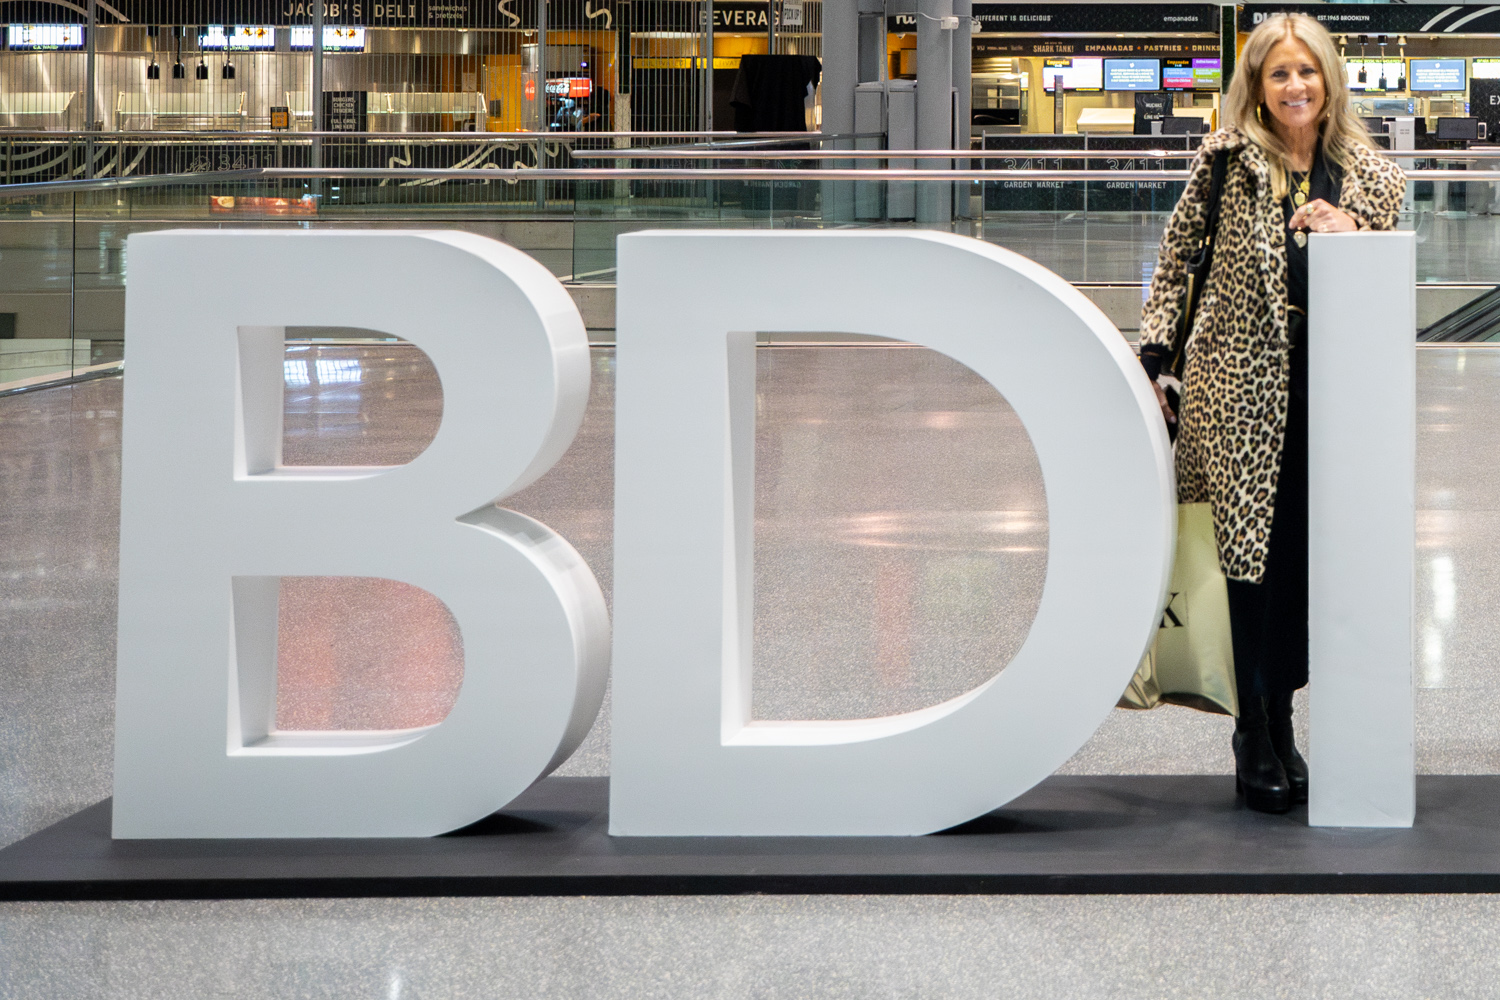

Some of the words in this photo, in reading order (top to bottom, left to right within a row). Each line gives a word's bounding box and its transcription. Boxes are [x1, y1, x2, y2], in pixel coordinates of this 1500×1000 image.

[284, 3, 362, 17] JACOB'S
[375, 4, 416, 18] DELI
[1033, 44, 1054, 53] SHARK
[1056, 44, 1074, 53] TANK!
[218, 154, 272, 171] 3411
[1004, 157, 1063, 170] 3411
[1106, 157, 1165, 170] 3411
[1004, 181, 1032, 189] GARDEN
[1037, 181, 1064, 189] MARKET
[1106, 181, 1134, 189] GARDEN
[1138, 181, 1167, 189] MARKET
